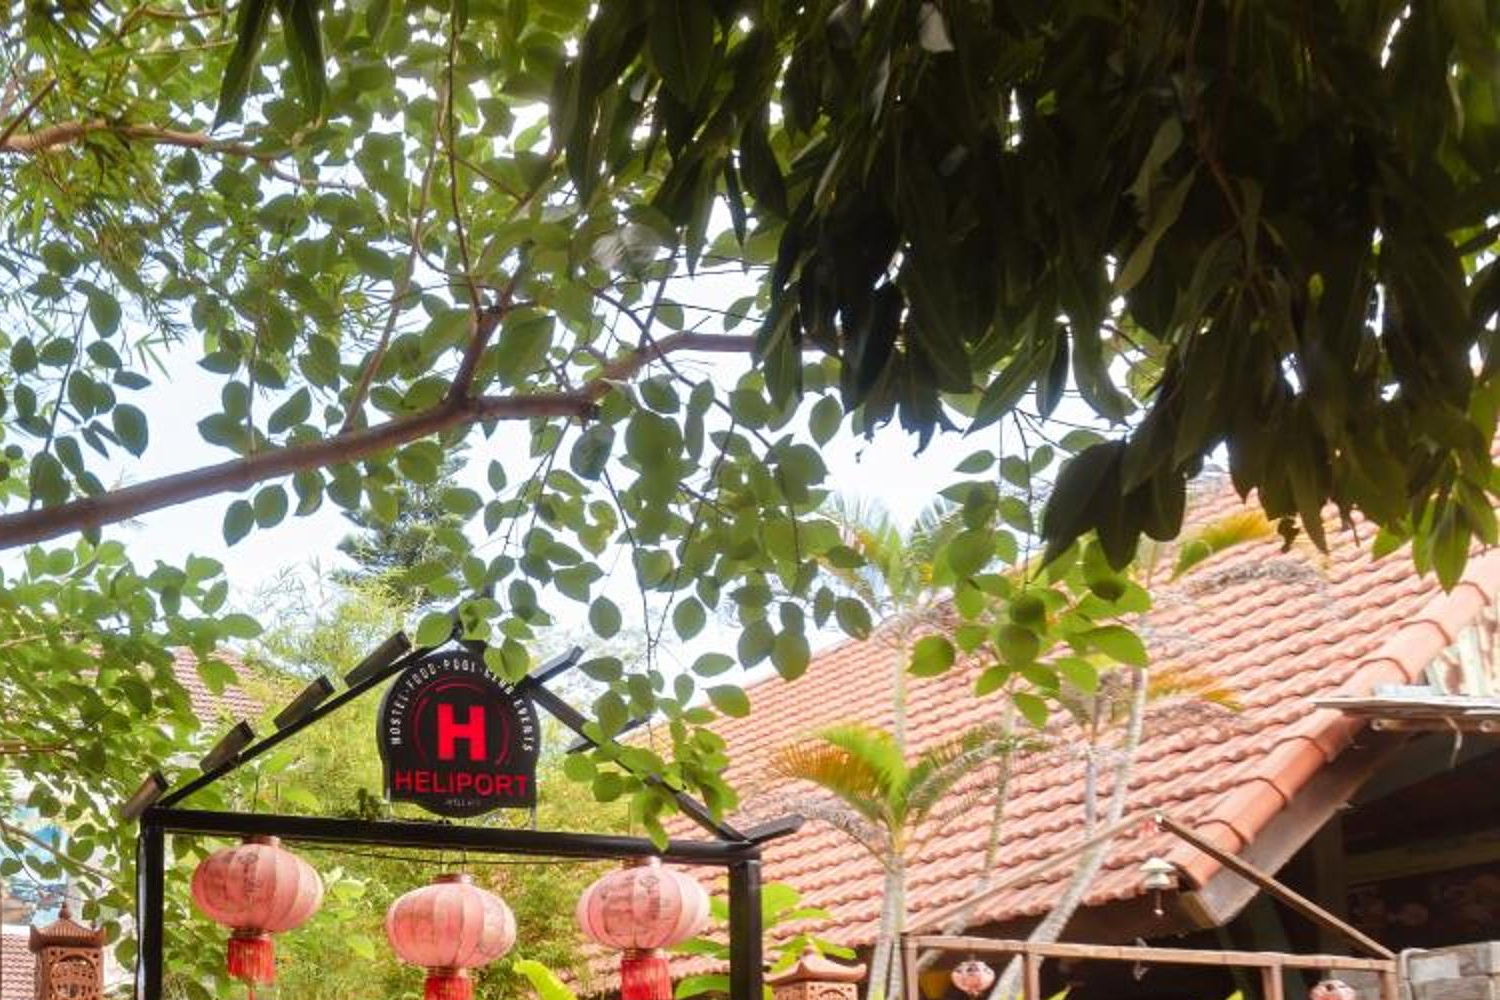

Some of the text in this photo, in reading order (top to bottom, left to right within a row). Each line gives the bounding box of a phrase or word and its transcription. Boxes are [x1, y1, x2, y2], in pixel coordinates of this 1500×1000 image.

[390, 693, 409, 745] HOSTEL
[405, 662, 436, 690] FOOD
[443, 658, 475, 673] POOL
[514, 699, 534, 751] EVENTS
[436, 702, 487, 761] H
[394, 768, 528, 797] HELIPORT
